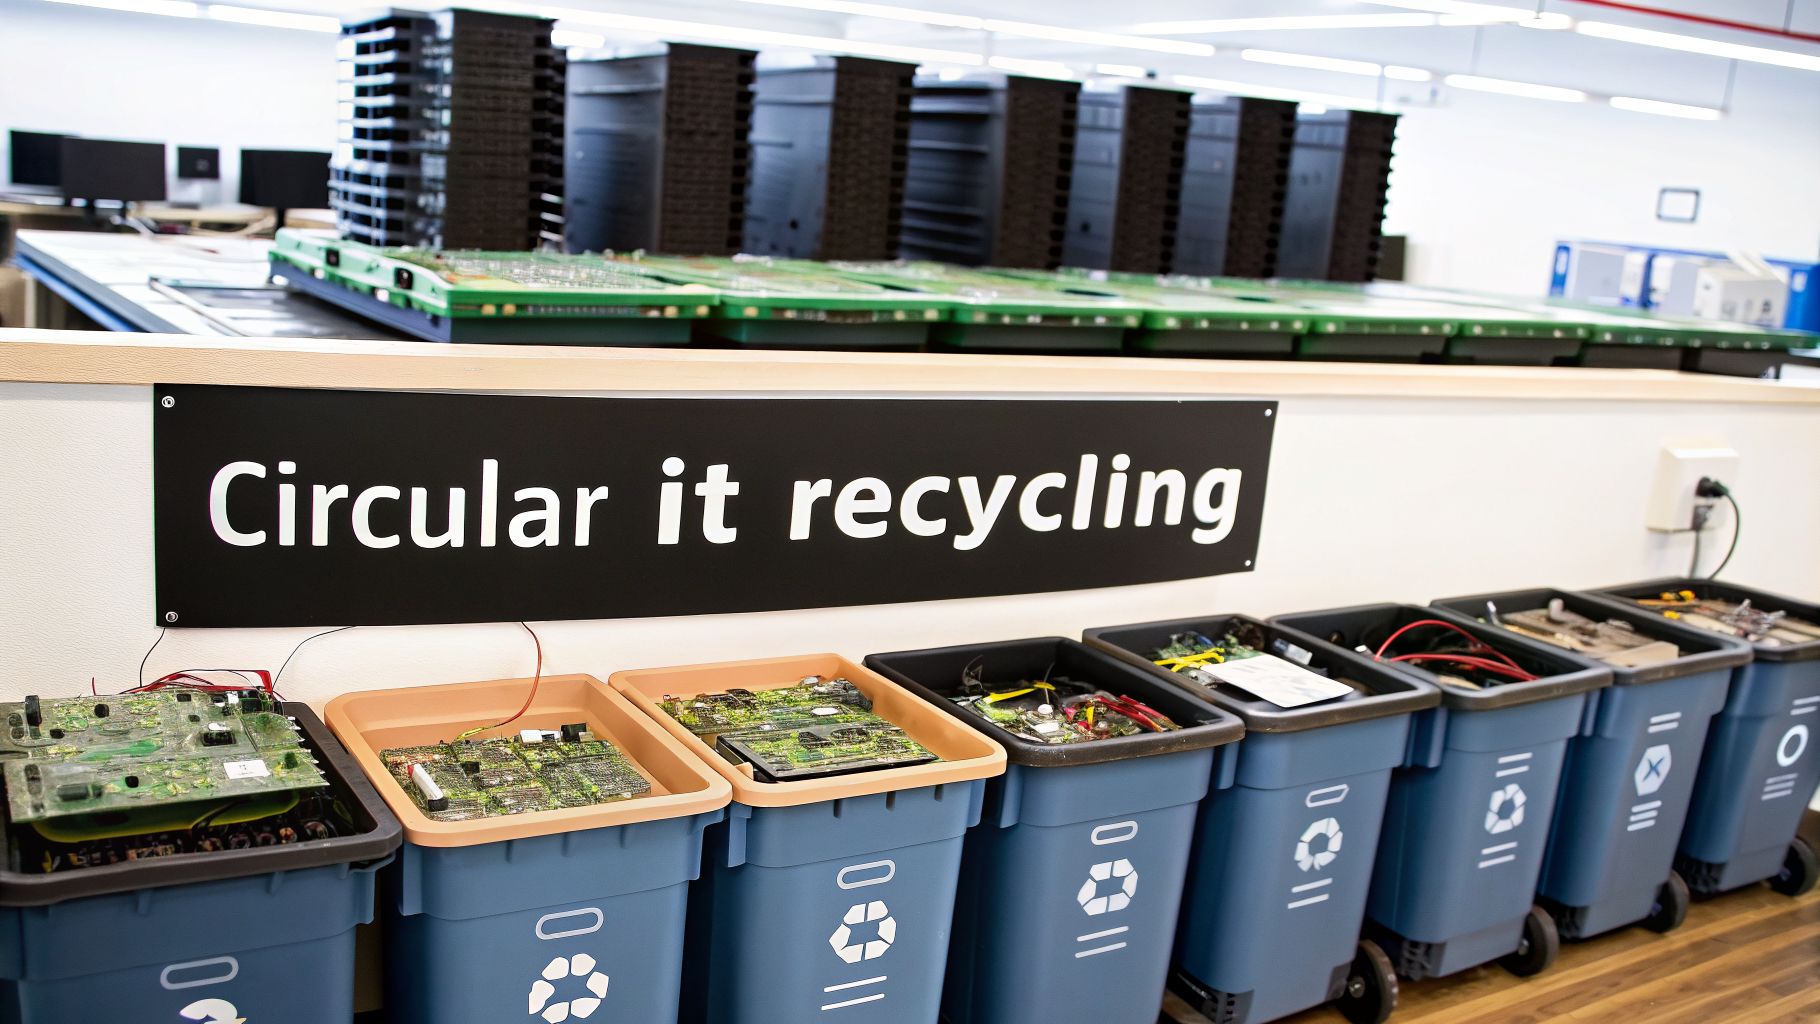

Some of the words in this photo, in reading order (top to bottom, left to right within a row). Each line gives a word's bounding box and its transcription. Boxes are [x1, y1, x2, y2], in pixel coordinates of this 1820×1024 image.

[209, 458, 609, 549] Circular
[657, 456, 740, 546] it
[789, 453, 1244, 551] recycling
